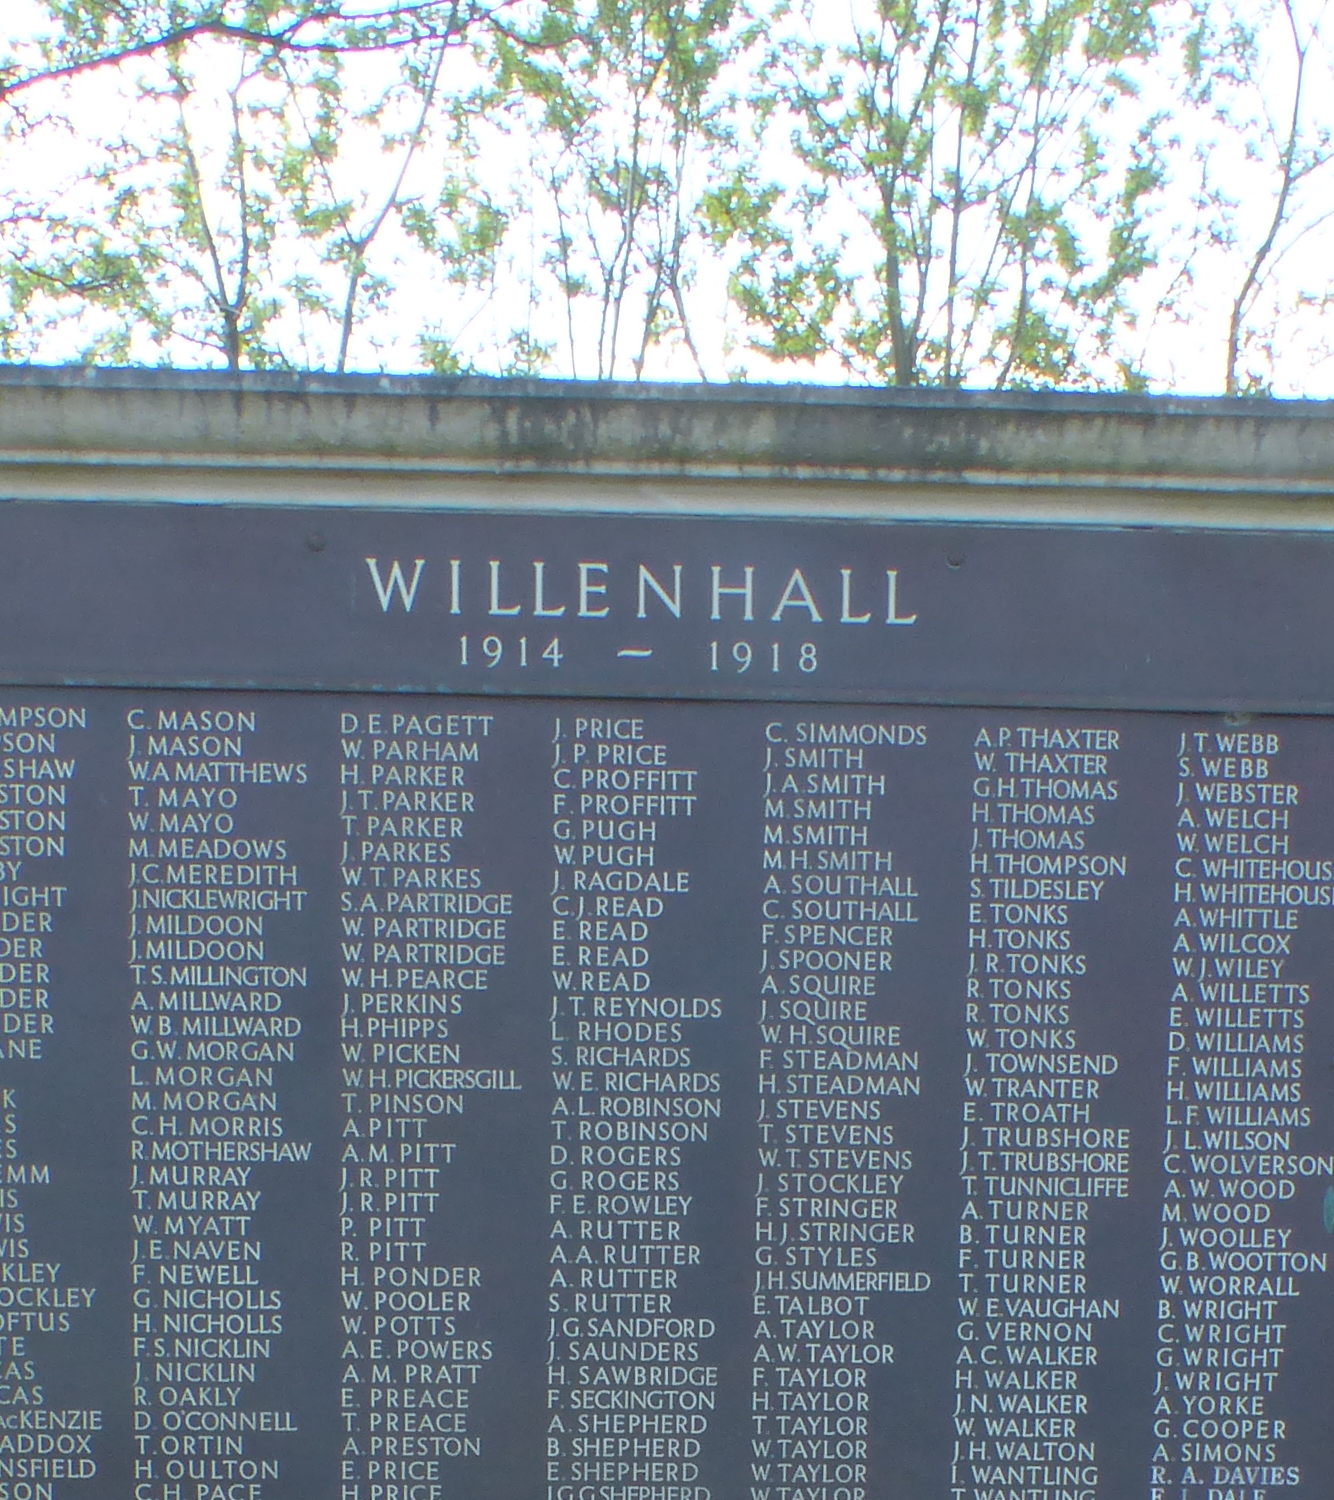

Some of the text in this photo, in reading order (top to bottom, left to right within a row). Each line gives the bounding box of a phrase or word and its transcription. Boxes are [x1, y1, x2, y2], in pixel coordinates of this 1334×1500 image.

[365, 557, 918, 626] WILLENHALL
[458, 636, 564, 668] 1914
[709, 640, 819, 673] 1918
[157, 709, 256, 733] MASON
[575, 717, 644, 740] PRICE
[795, 721, 928, 746] SIMMONDS
[784, 746, 864, 770] SMITH
[1004, 751, 1108, 775] THAXTER
[1201, 756, 1269, 779] WEBB
[158, 787, 238, 809] MAYO
[580, 793, 698, 817] PROFFITT
[1194, 781, 1300, 806] WEBSTER
[573, 869, 690, 893] RAGDALE
[988, 877, 1105, 901] TILDESLEY
[791, 899, 919, 923] SOUTHALL
[145, 913, 263, 937] MILDOON
[373, 916, 507, 940] PARTRIDGE
[784, 924, 893, 947] SPENCER
[373, 942, 506, 966] PARTRIDGE
[578, 945, 650, 968] READ
[778, 948, 893, 972] SPOONER
[158, 990, 282, 1013] MILLWARD
[1194, 1006, 1305, 1029] WILLETTS
[994, 1027, 1076, 1050] TONKS
[576, 1045, 691, 1068] RICHARDS
[984, 1052, 1119, 1075] TOWNSEND
[162, 1090, 277, 1112] MORGAN
[1193, 1080, 1302, 1103] WILLIAMS
[369, 1092, 464, 1115] PINSON
[776, 1098, 881, 1121] STEVENS
[981, 1126, 1131, 1149] TRUBSHORE
[580, 1144, 682, 1167] ROGERS
[983, 1175, 1130, 1198] TUNNICLIFFE
[157, 1189, 262, 1212] MURRAY
[778, 1196, 898, 1220] STRINGER
[164, 1215, 252, 1237] MYATT
[369, 1216, 427, 1238] PITT
[580, 1219, 681, 1241] RUTTER
[1178, 1226, 1293, 1249] WOOLLEY
[785, 1245, 877, 1268] STYLES
[373, 1266, 482, 1288] PONDER
[984, 1272, 1087, 1295] TURNER
[374, 1290, 471, 1312] POOLER
[1182, 1299, 1279, 1321] WRIGHT
[163, 1313, 283, 1335] NICHOLLS
[374, 1315, 456, 1337] POTTS
[568, 1340, 699, 1362] SAUNDERS
[578, 1365, 719, 1387] SAWBRIDGE
[774, 1366, 867, 1388] TAYLOR
[983, 1369, 1078, 1391] WALKER
[158, 1386, 242, 1407] OAKLY
[370, 1387, 470, 1409] PREACE
[370, 1435, 481, 1457] PRESTON
[1180, 1442, 1276, 1463] SIMONS
[165, 1459, 279, 1481] OULTON
[570, 1461, 699, 1482] SHEPHERD
[1149, 1465, 1301, 1486] R. A. DAVIES
